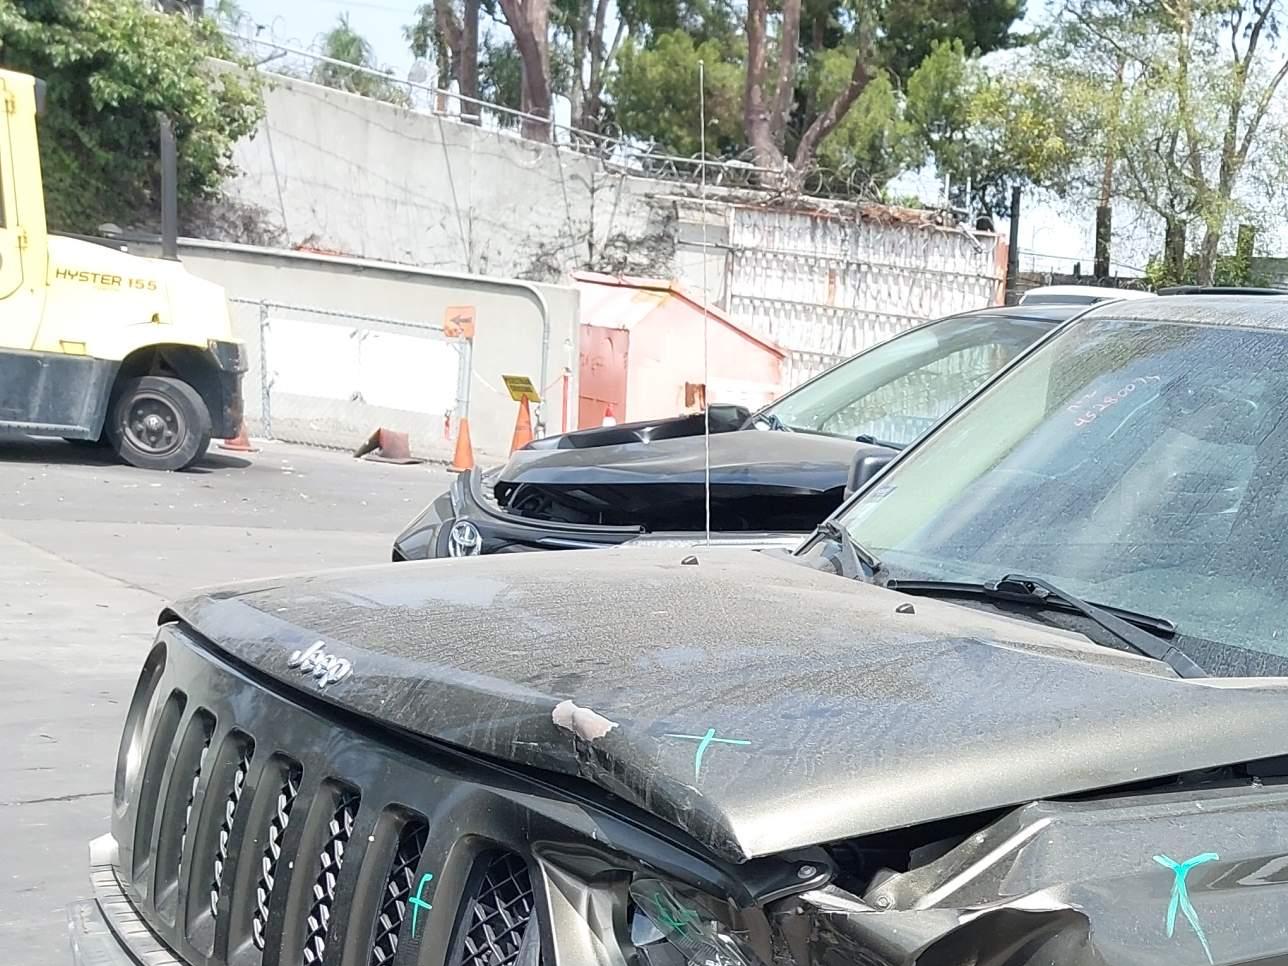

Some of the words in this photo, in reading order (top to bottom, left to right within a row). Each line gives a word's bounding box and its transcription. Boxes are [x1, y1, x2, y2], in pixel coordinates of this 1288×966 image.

[55, 267, 122, 287] HYSTER
[128, 277, 157, 291] 155
[287, 640, 353, 689] Jeep
